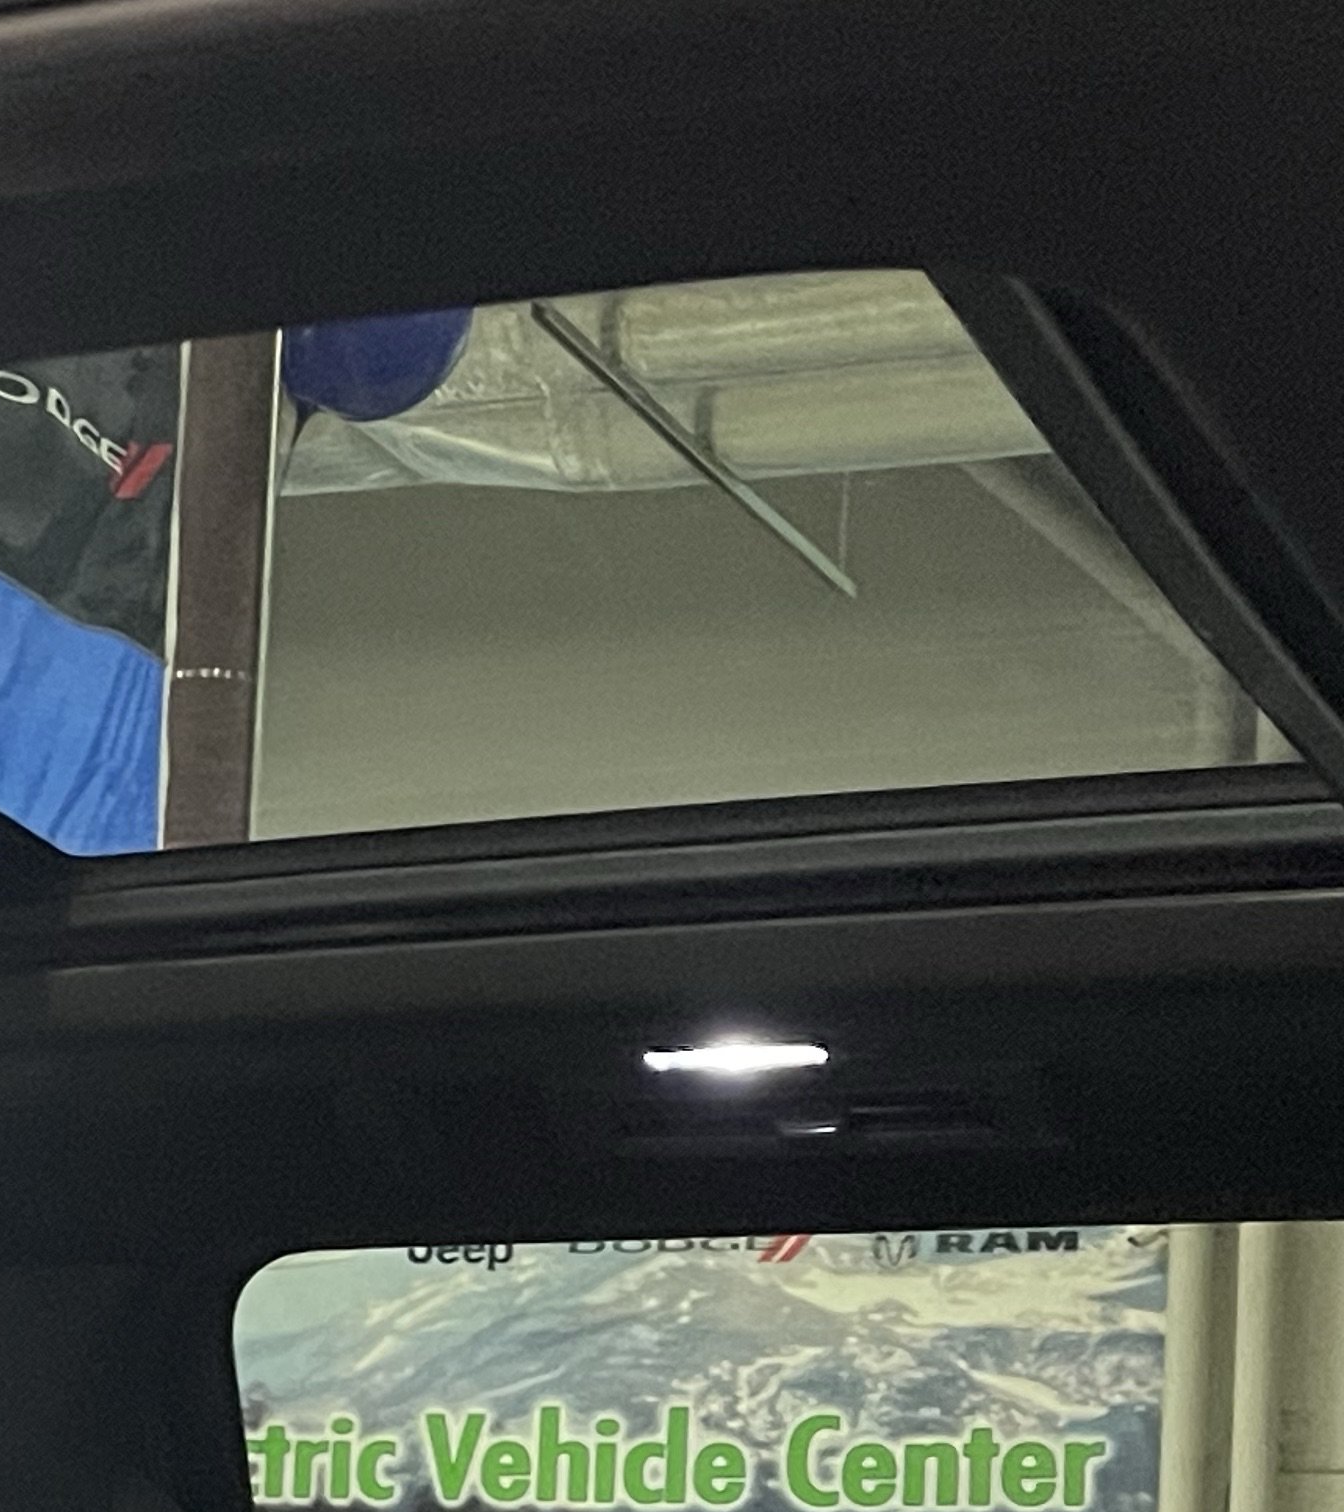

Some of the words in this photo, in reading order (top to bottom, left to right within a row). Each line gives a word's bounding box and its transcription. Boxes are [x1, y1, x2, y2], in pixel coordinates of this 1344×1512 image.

[936, 1231, 1079, 1253] RAM
[246, 1417, 396, 1500] tric
[425, 1406, 747, 1505] Vehicle
[786, 1414, 1106, 1507] Center
